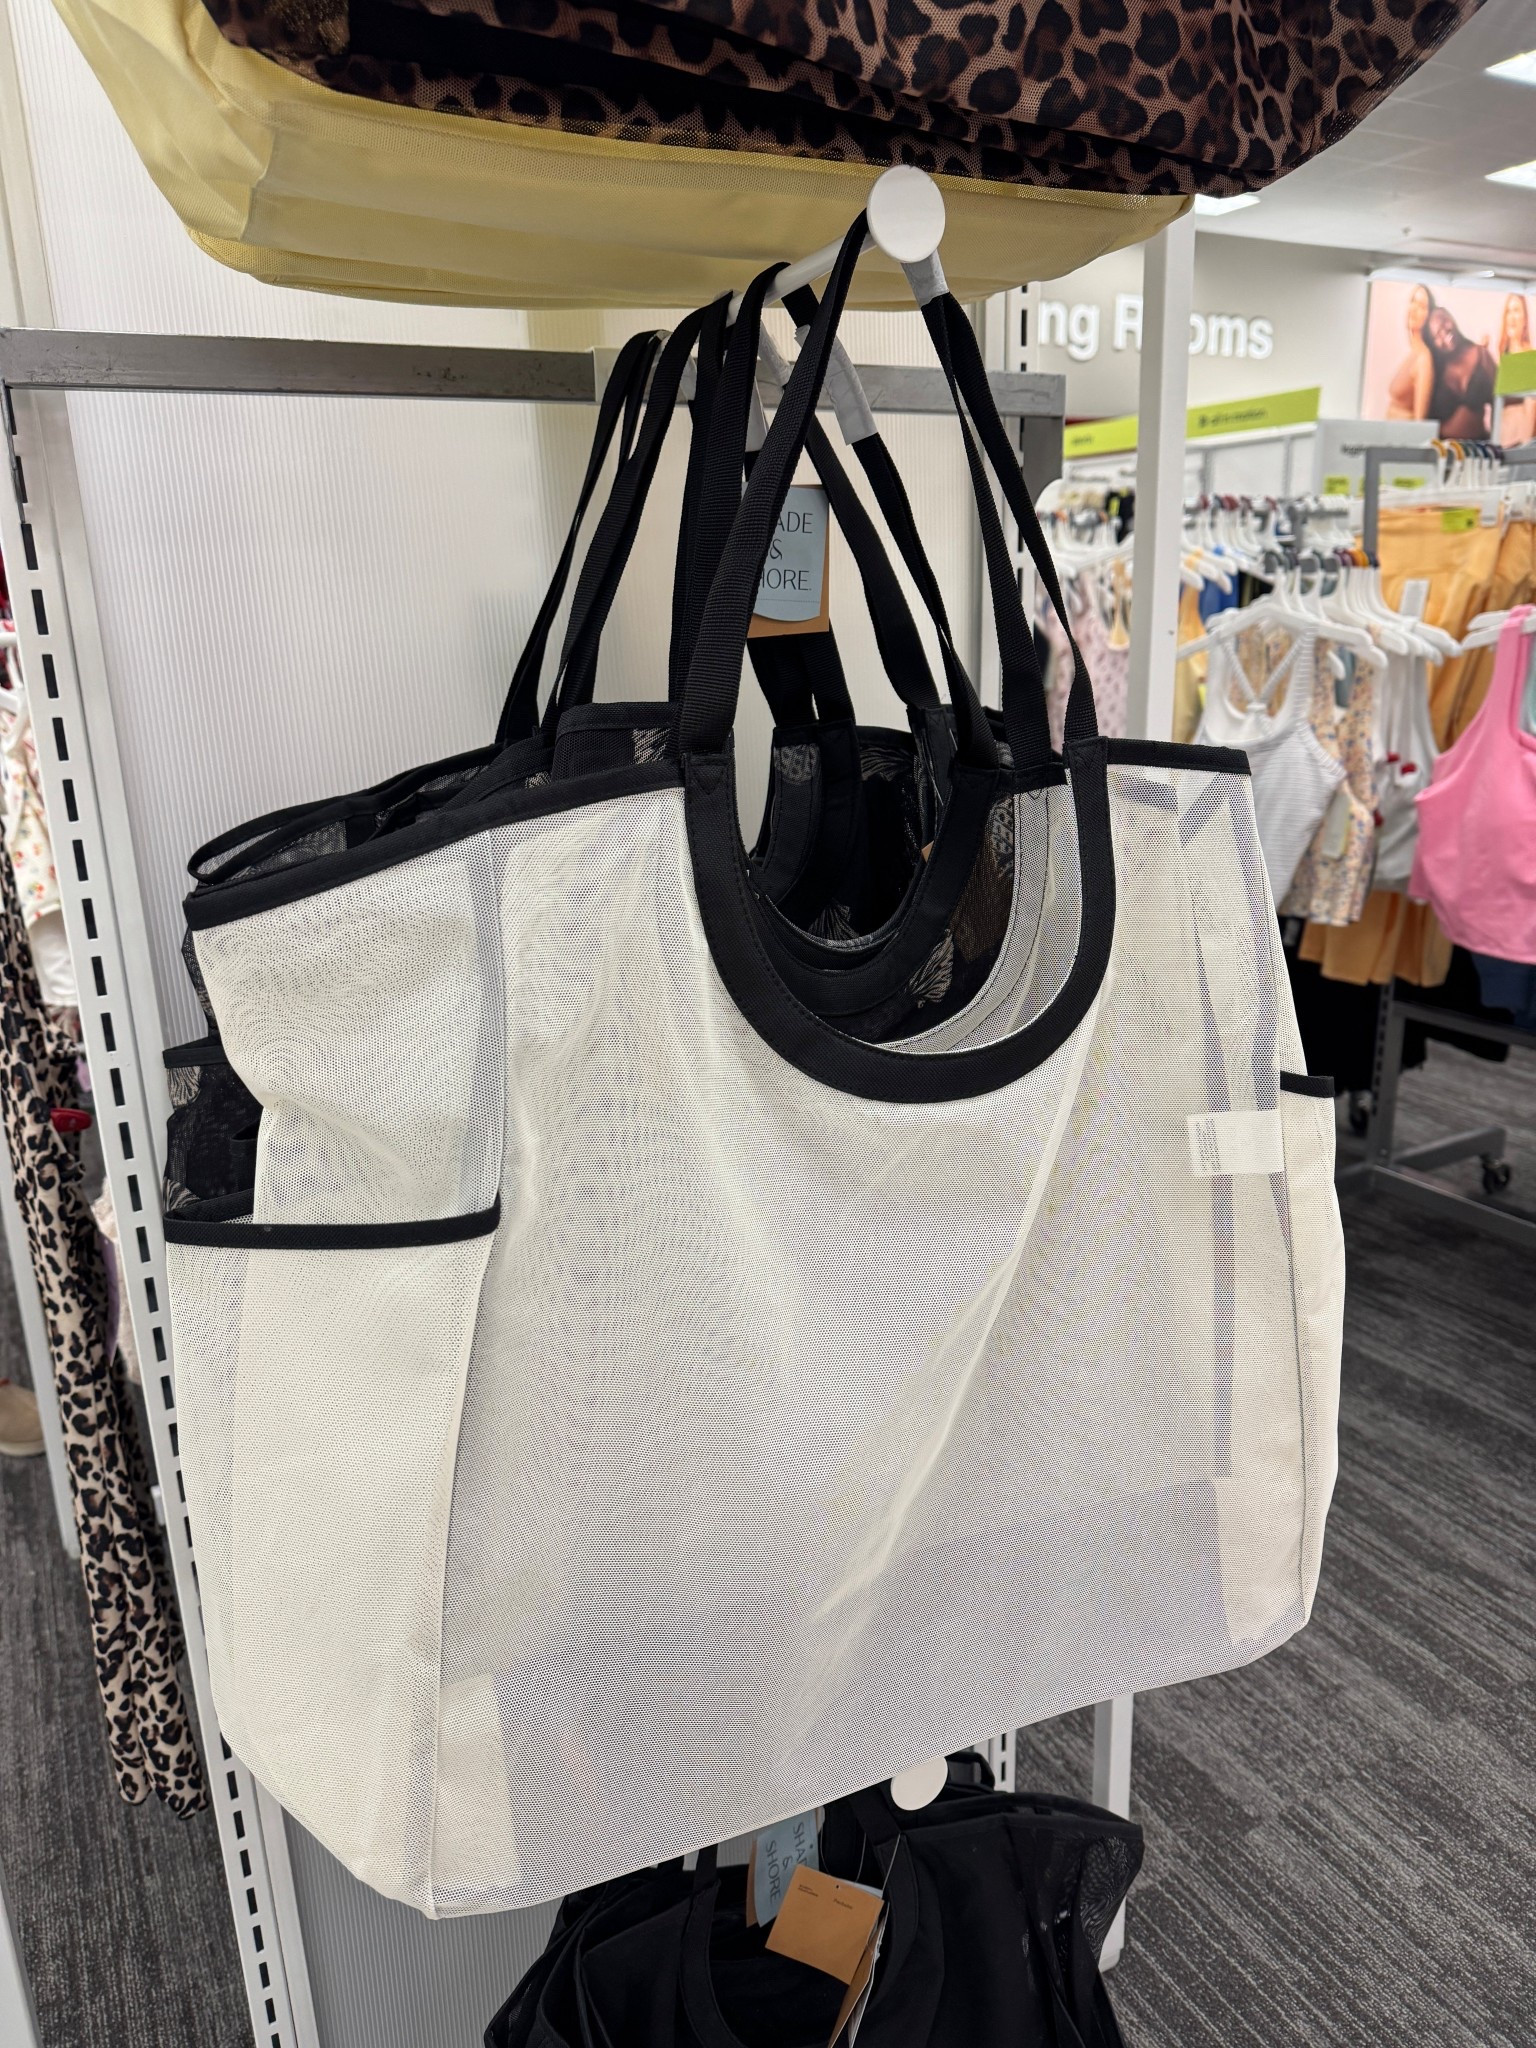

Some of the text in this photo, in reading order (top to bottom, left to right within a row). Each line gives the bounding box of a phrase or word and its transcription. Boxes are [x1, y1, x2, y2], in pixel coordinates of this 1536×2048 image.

[1113, 294, 1275, 360] Roms
[770, 538, 783, 560] &
[766, 1840, 781, 1904] SHORE
